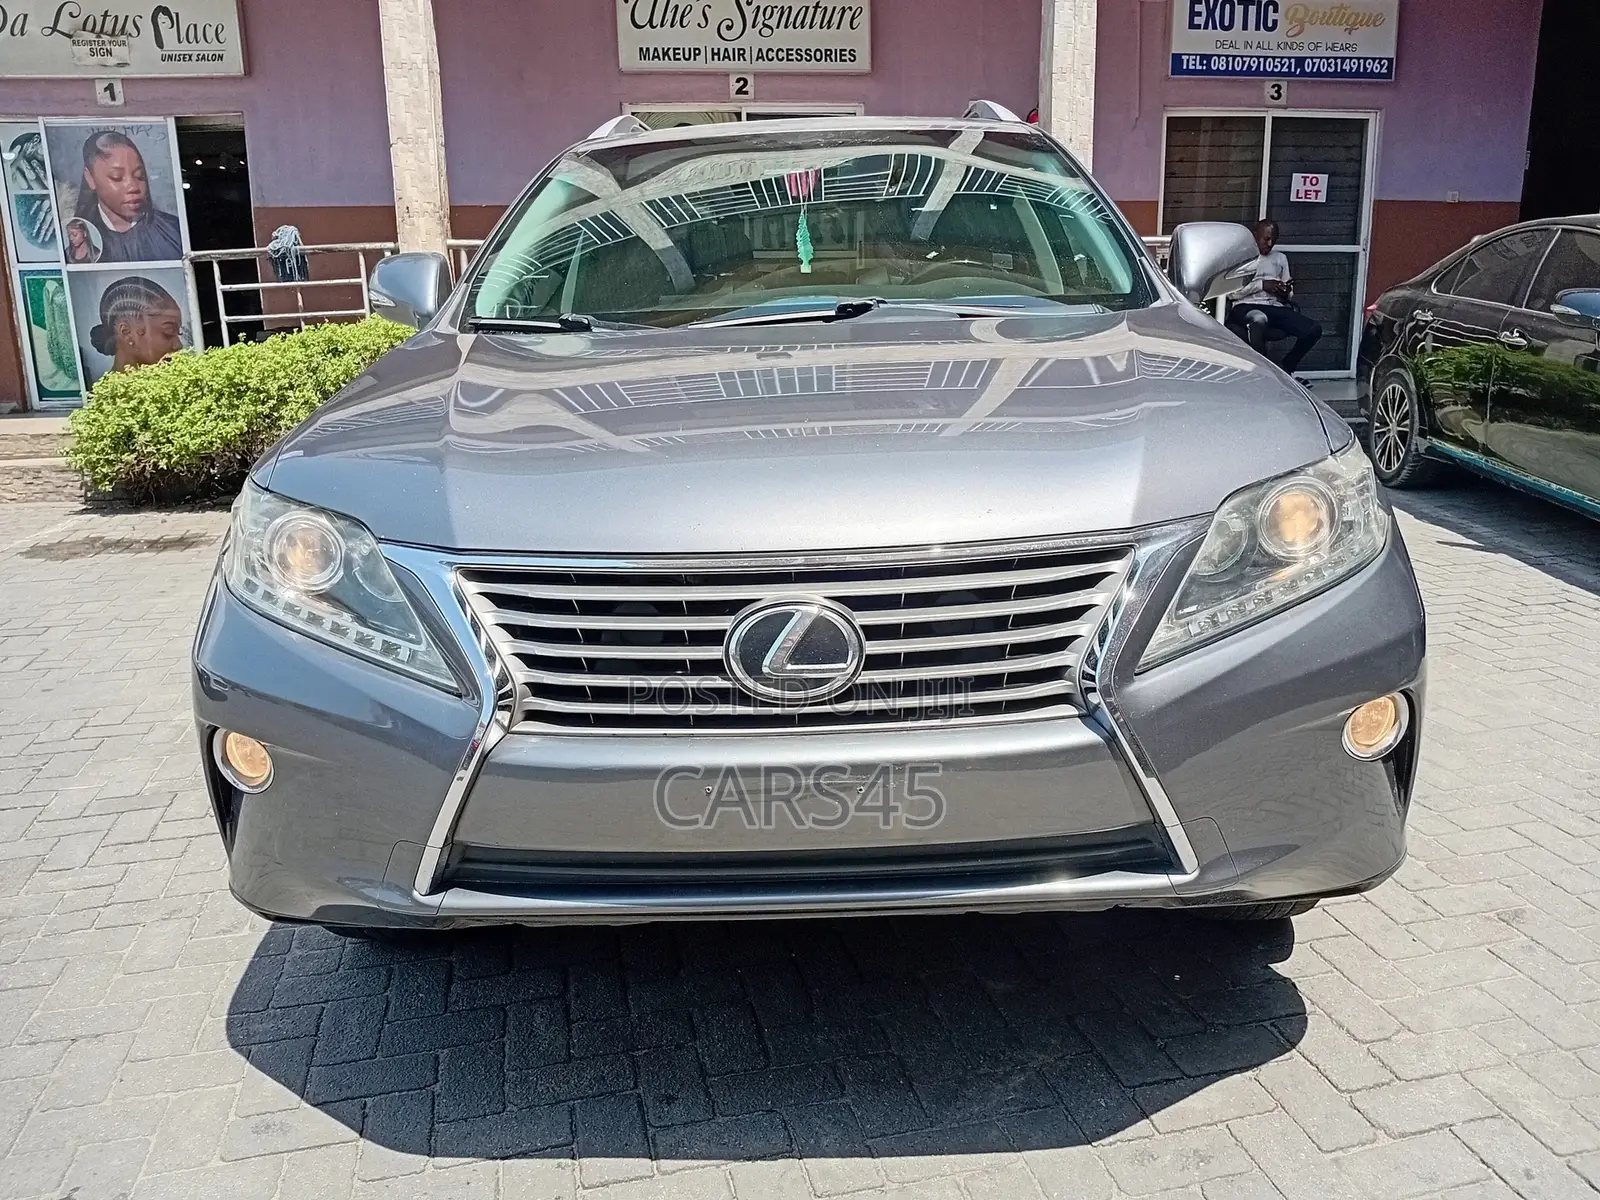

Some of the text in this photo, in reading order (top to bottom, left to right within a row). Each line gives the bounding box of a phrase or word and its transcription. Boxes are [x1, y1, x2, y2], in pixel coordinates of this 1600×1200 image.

[41, 1, 143, 39] Lotus
[717, 0, 864, 42] Signature
[1188, 0, 1386, 38] EXOTIC Boutique
[72, 39, 107, 47] REGISTER
[1215, 40, 1358, 53] DEAL IN ALL KINDS OF WEARS
[89, 47, 113, 57] SIGN
[161, 53, 224, 62] UNISEX SALON
[638, 46, 857, 63] MAKEUP HAIR ACCESSORIES
[1181, 55, 1388, 75] TEL: 08107910521, 07031491962
[103, 83, 117, 102] 1
[735, 77, 749, 95] 2
[1269, 84, 1282, 101] 3
[1301, 176, 1319, 186] TO
[1295, 189, 1321, 200] LET
